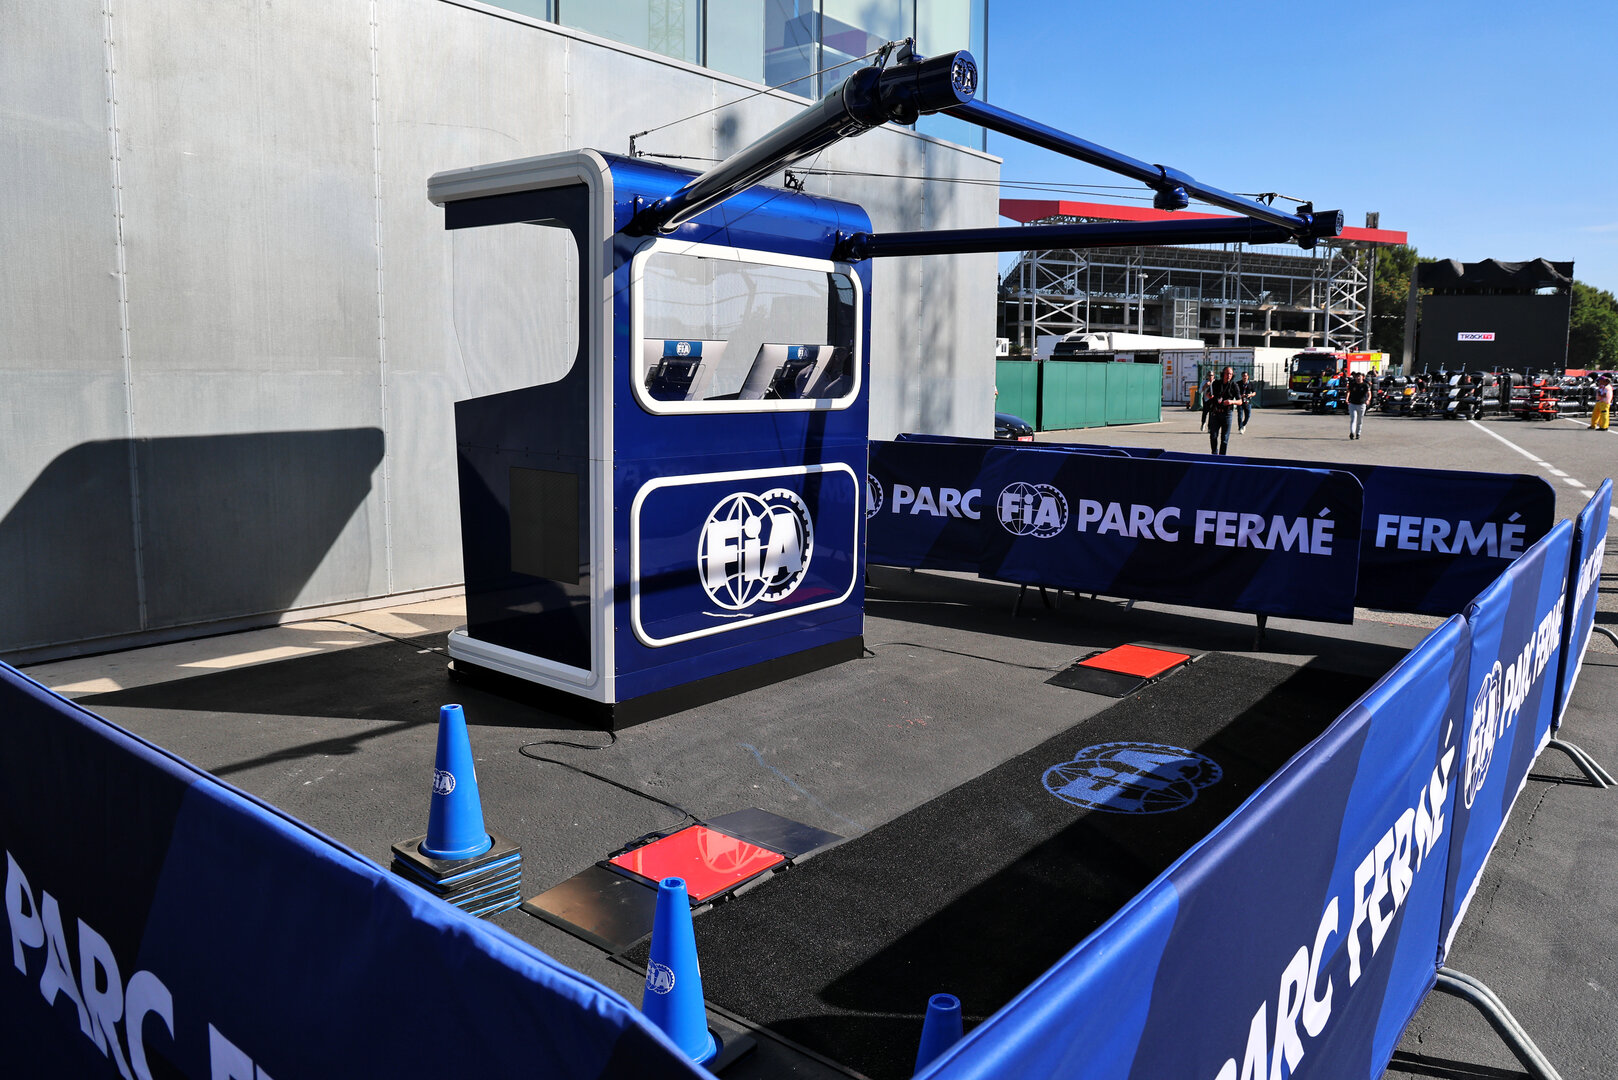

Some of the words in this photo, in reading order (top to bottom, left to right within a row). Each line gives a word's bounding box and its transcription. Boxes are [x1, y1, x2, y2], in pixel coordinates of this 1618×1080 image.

[891, 483, 982, 520] PARC
[1077, 498, 1181, 543] PARC
[1194, 506, 1335, 556] FERMÉ
[1375, 511, 1527, 560] FERMÉ
[1499, 631, 1537, 739] PARC
[1531, 577, 1566, 685] FERMÉ
[1347, 718, 1456, 988] FERMÉ
